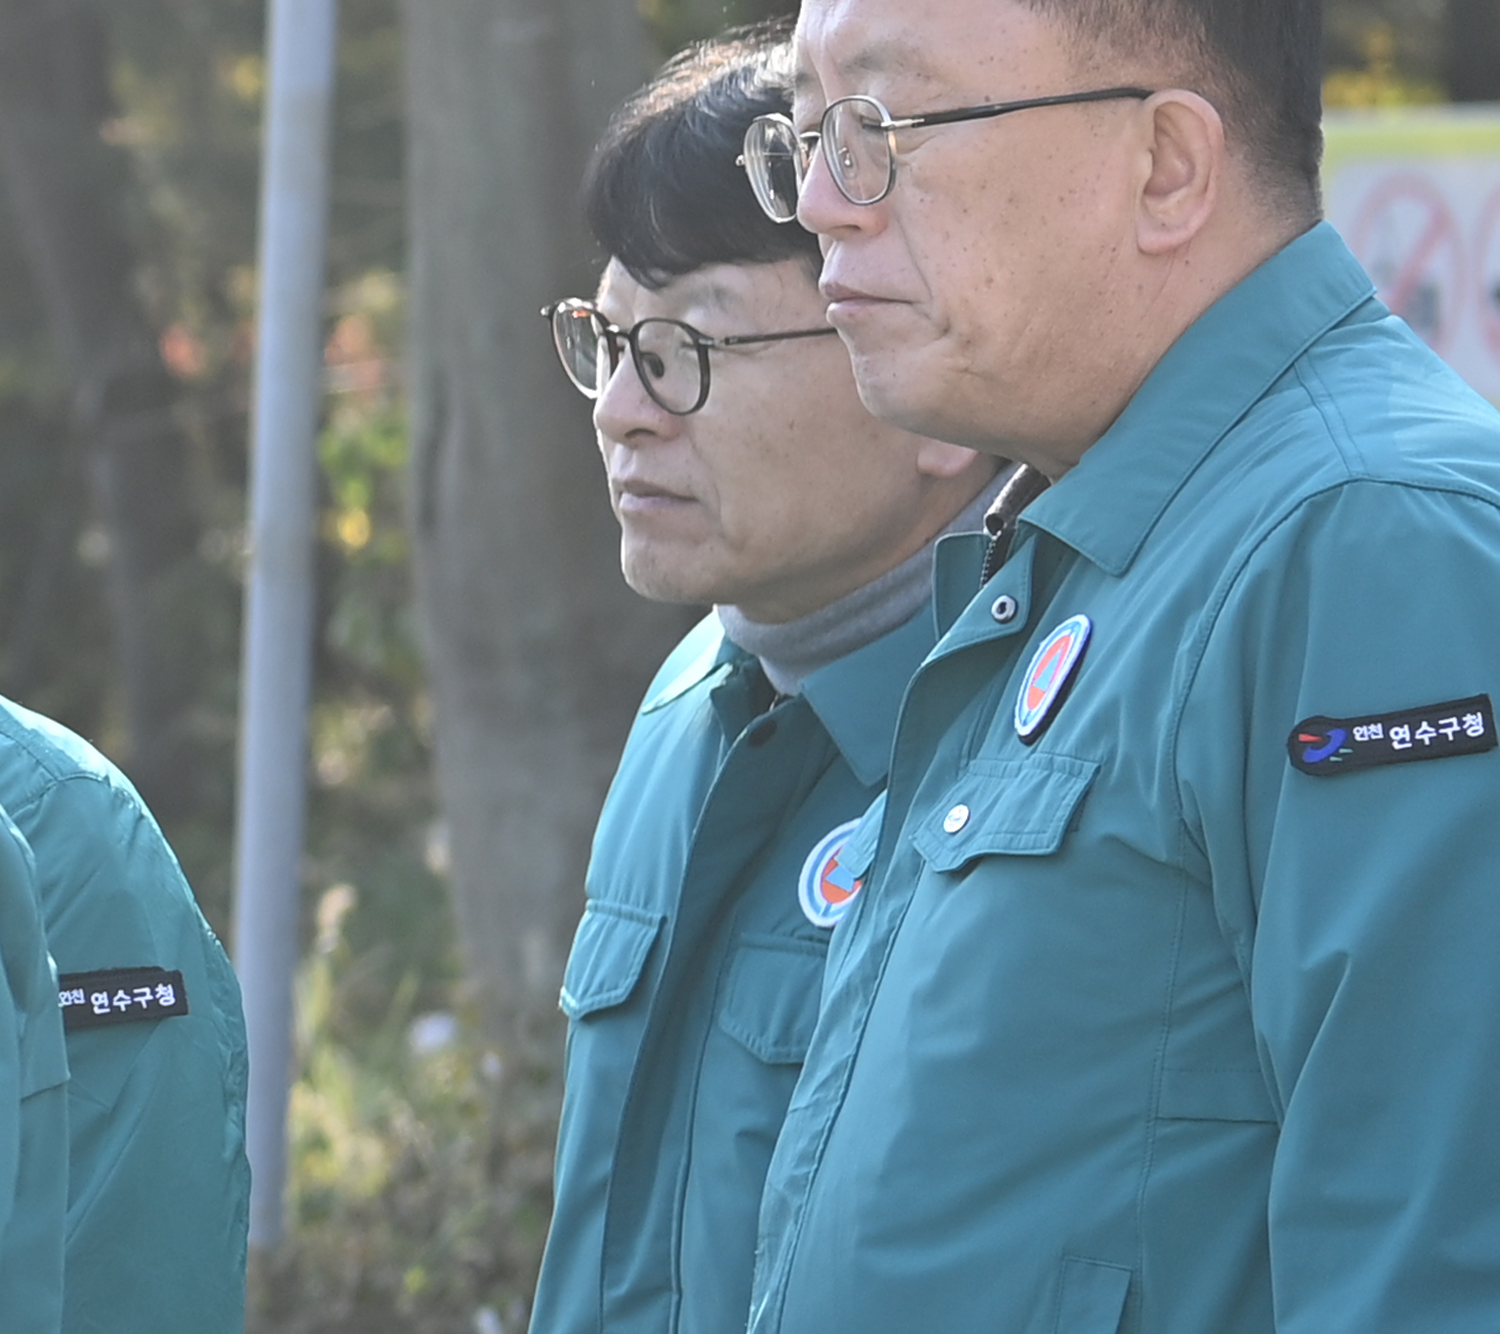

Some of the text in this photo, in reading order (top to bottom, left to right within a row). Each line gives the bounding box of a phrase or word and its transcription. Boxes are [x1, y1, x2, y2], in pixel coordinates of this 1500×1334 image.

[1352, 712, 1485, 750] 인천 연수구청
[90, 983, 176, 1014] 연수구청
